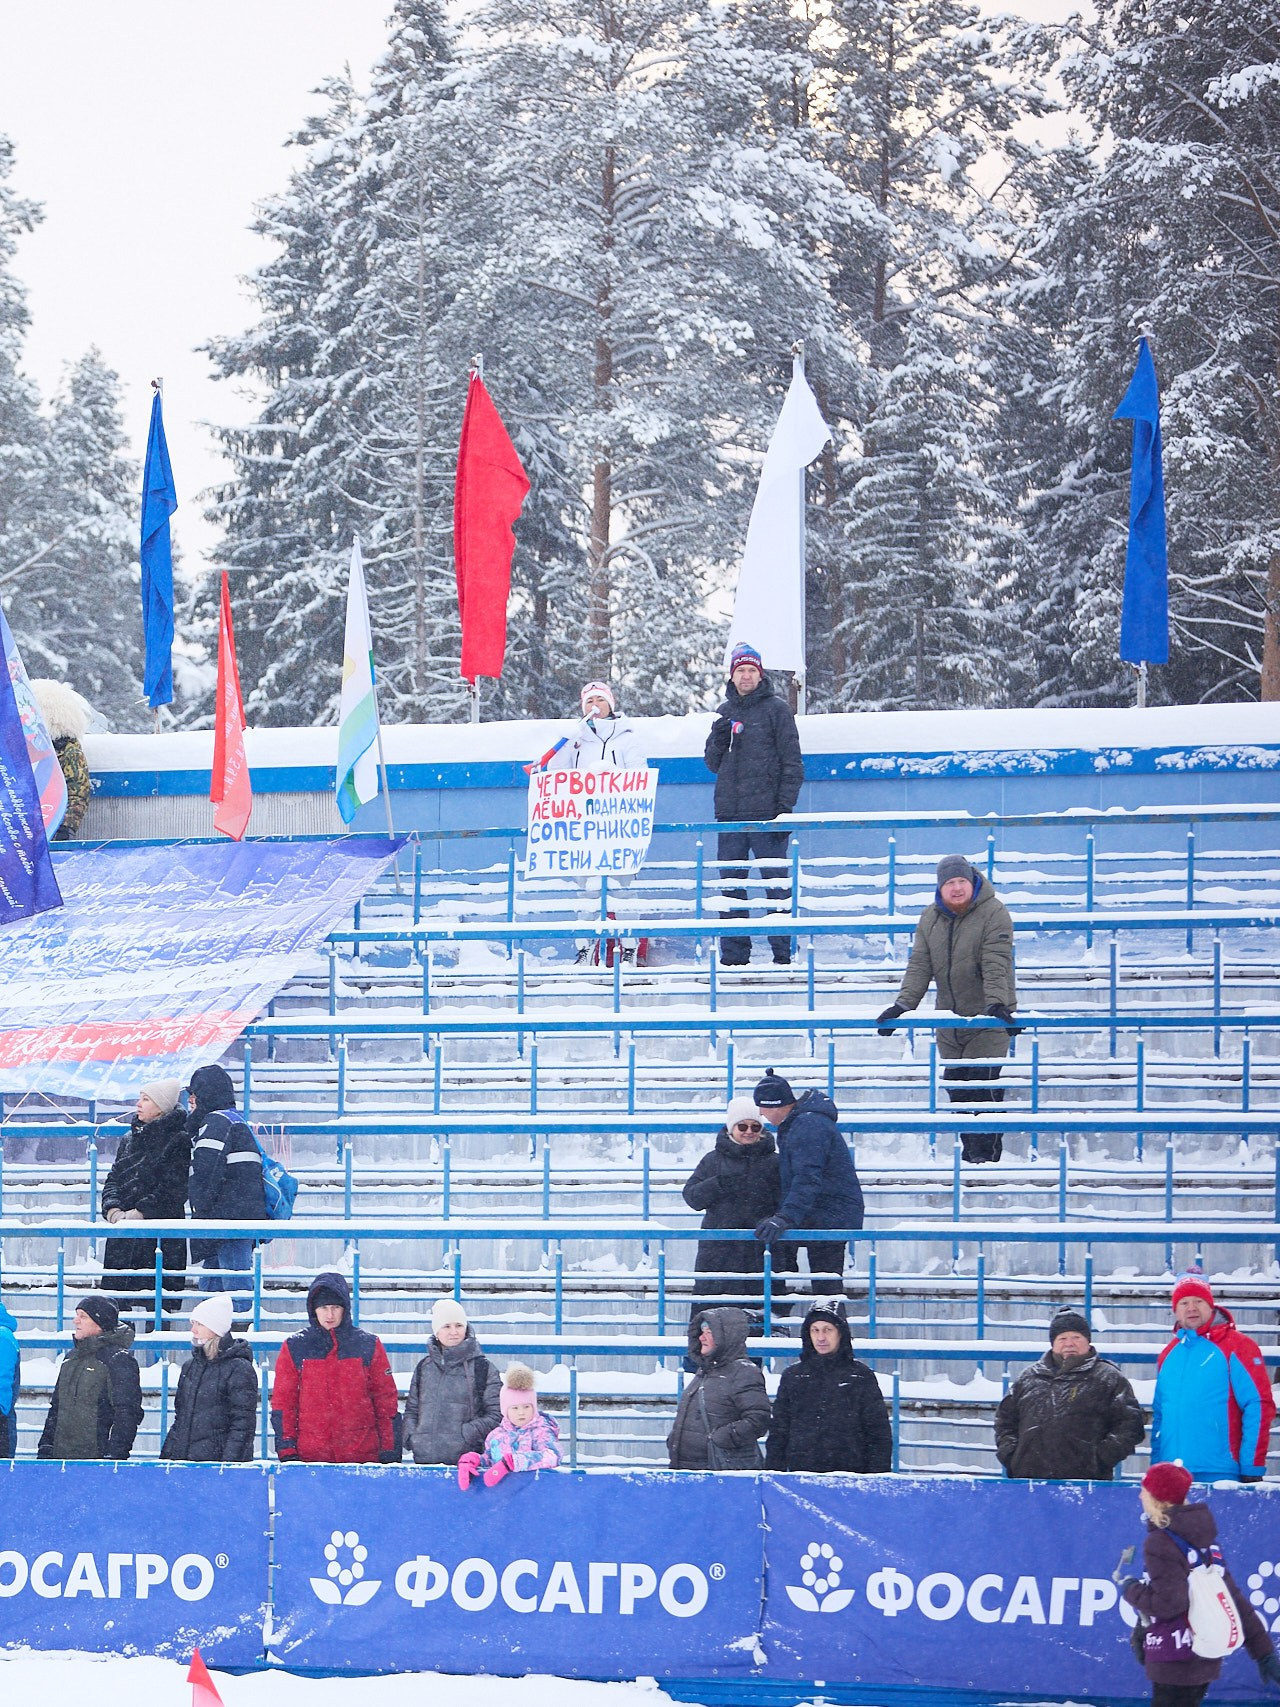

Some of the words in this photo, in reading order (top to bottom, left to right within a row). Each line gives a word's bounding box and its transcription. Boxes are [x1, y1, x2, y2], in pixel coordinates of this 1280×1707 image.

[536, 771, 649, 798] ЧЕРВОТКИН
[532, 798, 582, 821] ЛЁША,
[586, 798, 653, 816] ПОДНАЖМИ
[530, 818, 651, 844] СОПЕРНИКОВ
[529, 852, 537, 871] В
[543, 850, 591, 870] ТЕНИ
[595, 848, 648, 870] ДЕРЖИ
